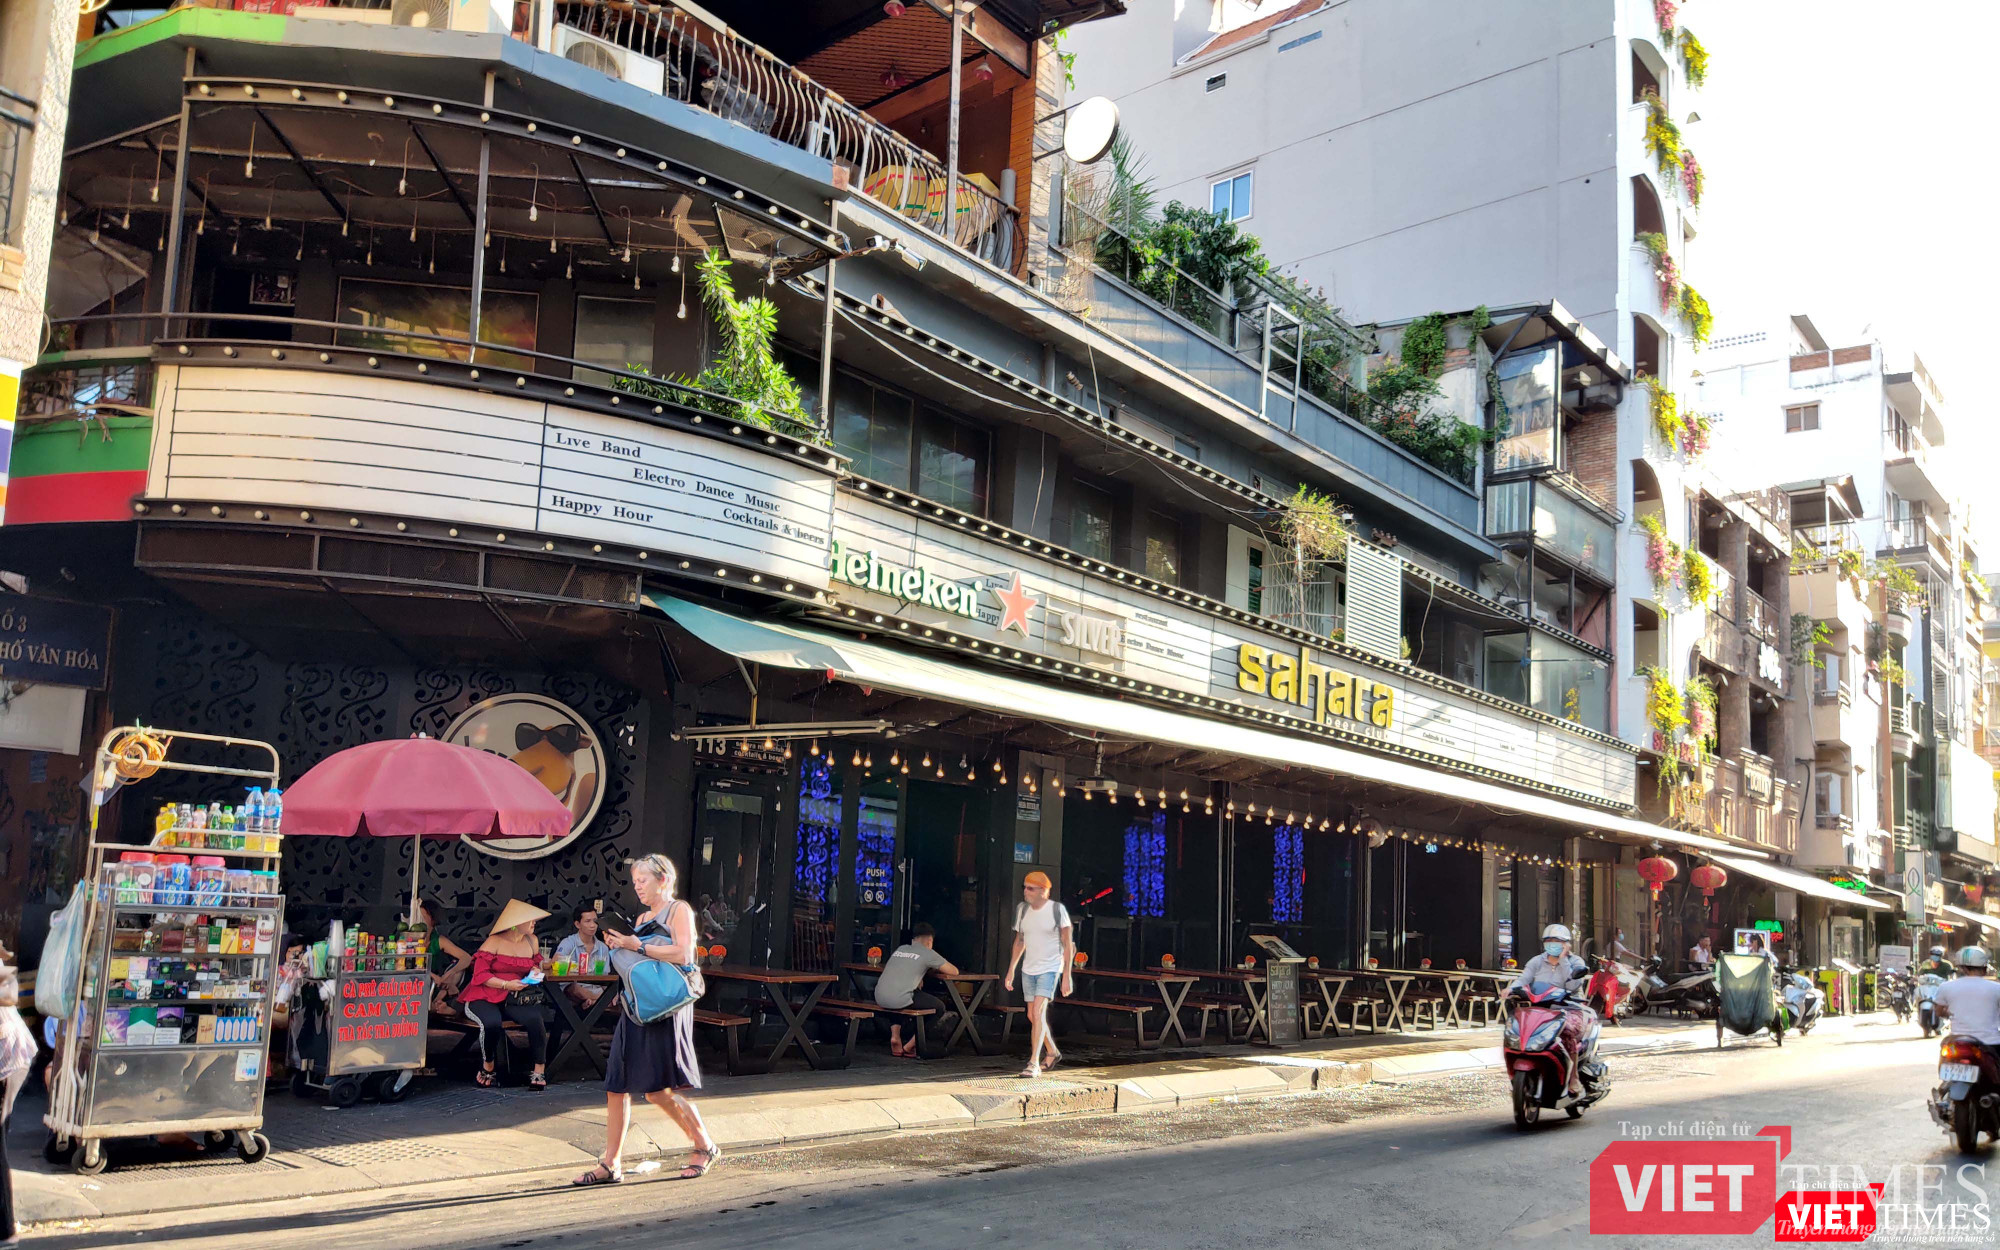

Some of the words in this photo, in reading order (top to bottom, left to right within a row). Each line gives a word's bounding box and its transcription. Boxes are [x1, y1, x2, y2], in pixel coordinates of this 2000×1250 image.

[555, 432, 591, 449] Live
[600, 440, 641, 458] Band
[633, 467, 686, 488] Electro
[696, 481, 735, 500] Dance
[744, 493, 781, 512] Music
[551, 495, 603, 516] Happy
[613, 506, 654, 523] Hour
[723, 508, 779, 532] Cocktails
[782, 524, 792, 535] &
[797, 526, 825, 545] beers
[18, 616, 27, 632] 3
[1060, 611, 1121, 658] SILVER
[0, 639, 25, 661] HỐ
[64, 648, 99, 670] HÓA
[1238, 643, 1394, 729] sahara
[1326, 714, 1356, 731] beer
[695, 738, 727, 755] 113
[866, 868, 886, 877] PUSH
[343, 1002, 382, 1018] CAM
[385, 996, 421, 1016] VẮT
